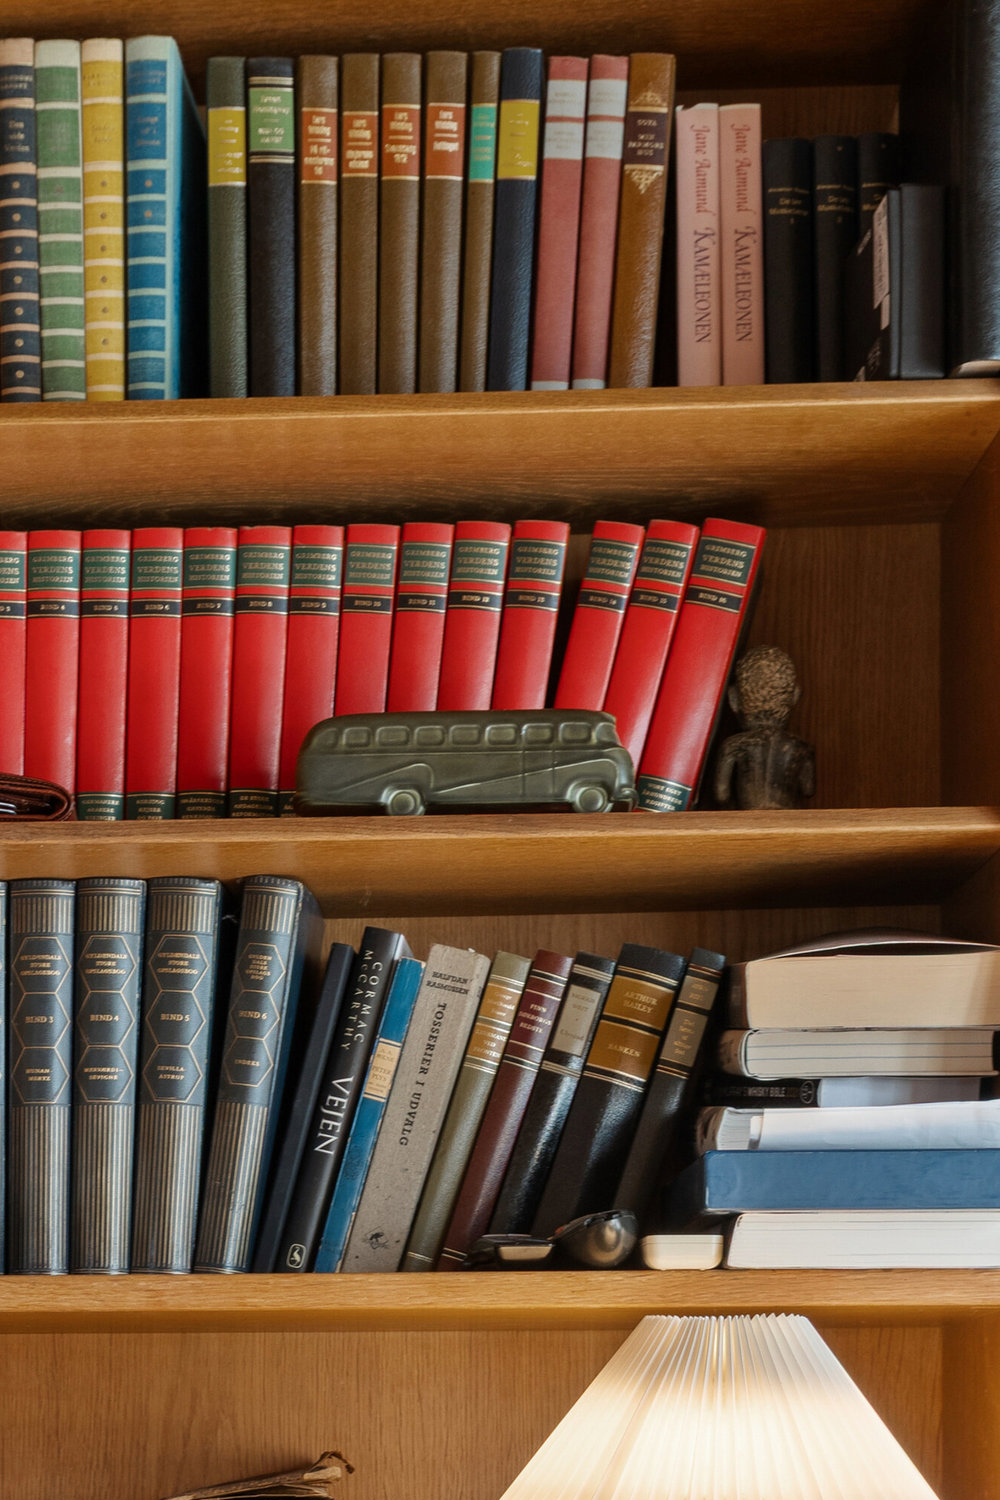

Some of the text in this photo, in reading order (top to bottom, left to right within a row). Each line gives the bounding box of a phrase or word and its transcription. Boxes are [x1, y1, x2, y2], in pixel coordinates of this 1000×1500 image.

[690, 124, 718, 344] Jane Aamund KAMÆLEONEN
[729, 123, 758, 343] Jane Aamund KAMÆLEONEN
[432, 971, 469, 985] HALFDAN
[426, 980, 470, 996] RASMUSSEN
[354, 962, 383, 1043] CORMAC
[623, 991, 658, 1006] ARTHUR
[25, 1015, 54, 1023] BIND 3
[113, 1014, 120, 1022] 4
[160, 1013, 183, 1021] BIND
[240, 1010, 268, 1020] BIND 6
[418, 1002, 448, 1076] TOSSERIER
[748, 1086, 770, 1097] WHISKY
[769, 1086, 786, 1097] BIBLE
[314, 1076, 354, 1156] VEJEN
[399, 1092, 422, 1147] UDVALG
